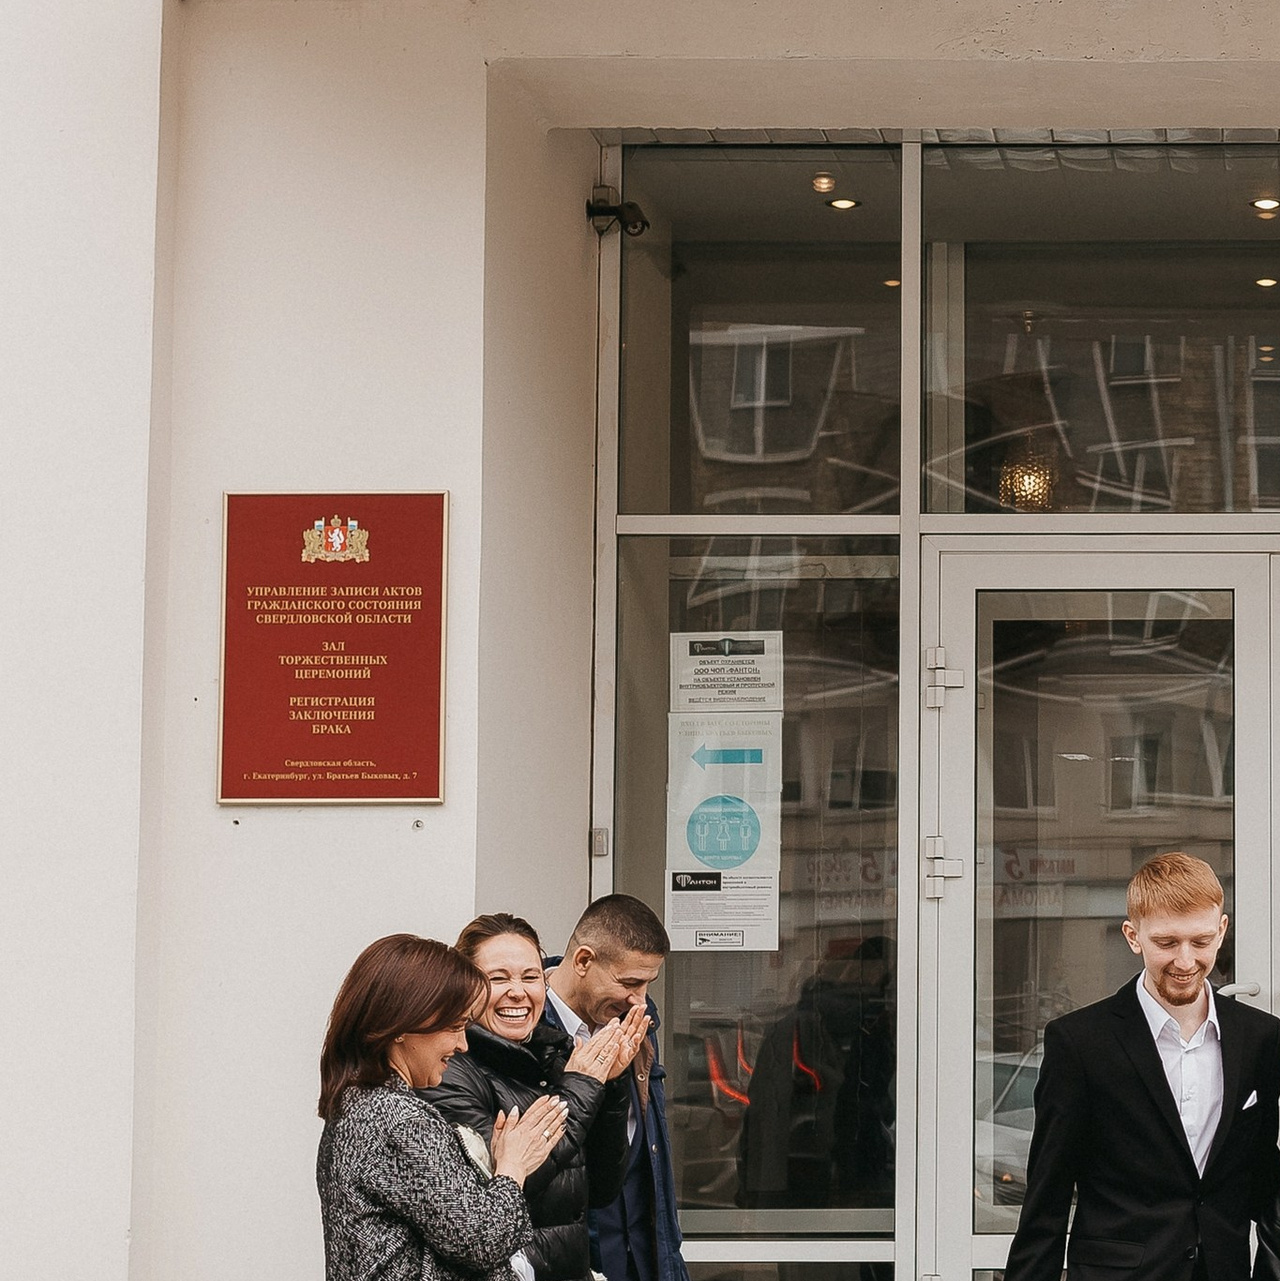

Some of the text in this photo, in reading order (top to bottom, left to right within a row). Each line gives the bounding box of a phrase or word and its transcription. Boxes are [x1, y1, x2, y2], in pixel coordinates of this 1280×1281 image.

[248, 587, 422, 597] УПРАВЛЕНИЕ ЗАПИСИ АКТОВ
[248, 601, 421, 611] ГРАЖДАНСКОГО СОСТОЯНИЯ
[256, 612, 411, 625] СВЕРДЛОВСКОЙ ОБЛАСТИ
[323, 642, 344, 652] ЗАЛ
[279, 656, 387, 666] ТОРЖЕСТВЕННЫХ
[295, 667, 370, 680] ЦЕРЕМОНИЙ
[290, 697, 374, 708] РЕГИСТРАЦИЯ
[289, 711, 374, 721] ЗАКЛЮЧЕНИЯ
[313, 725, 351, 734] БРАКА
[285, 760, 341, 769] Свердловская
